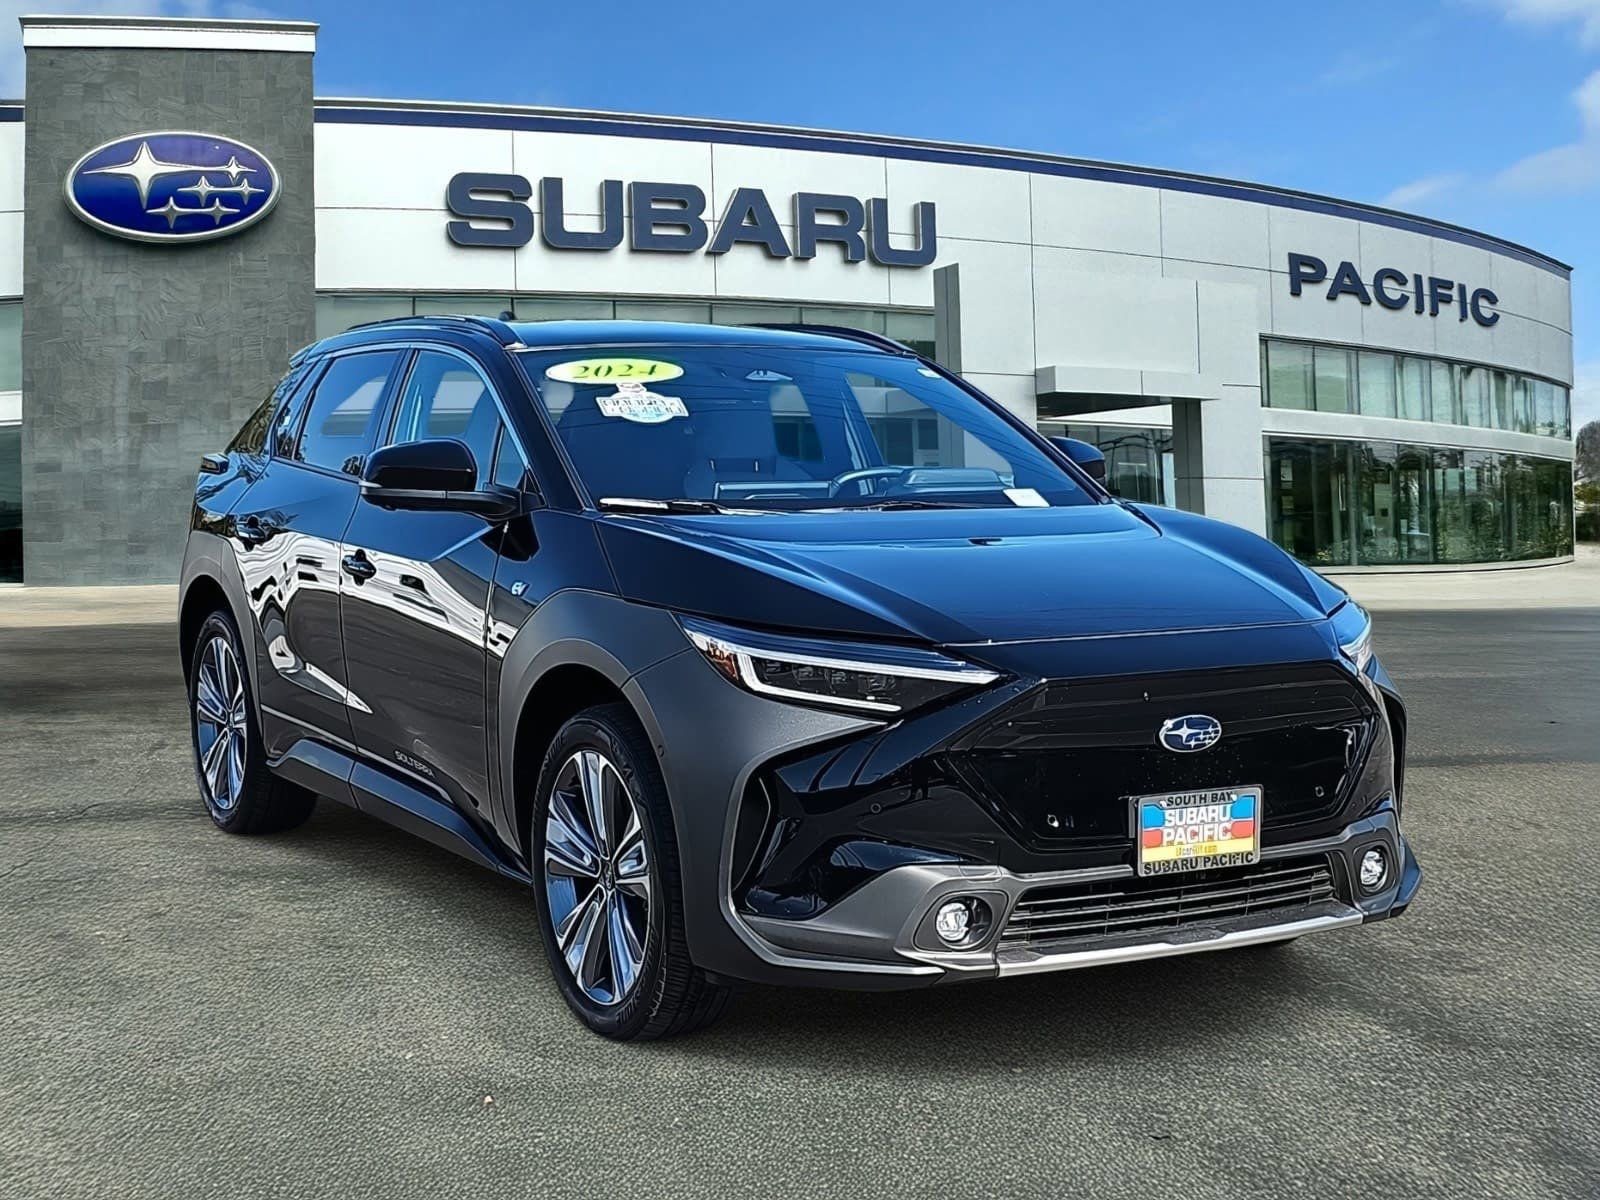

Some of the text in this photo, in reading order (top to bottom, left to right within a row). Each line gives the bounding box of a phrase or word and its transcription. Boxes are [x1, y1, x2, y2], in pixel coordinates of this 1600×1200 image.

[446, 172, 937, 268] SUBARU
[1288, 252, 1500, 327] PACIFIC
[573, 364, 657, 379] 2024
[1167, 791, 1234, 807] SOUTH BAY
[1165, 804, 1232, 827] SUBARU
[1162, 822, 1232, 847] PACIFIC
[1144, 852, 1254, 875] SUBARU PACIFIC
